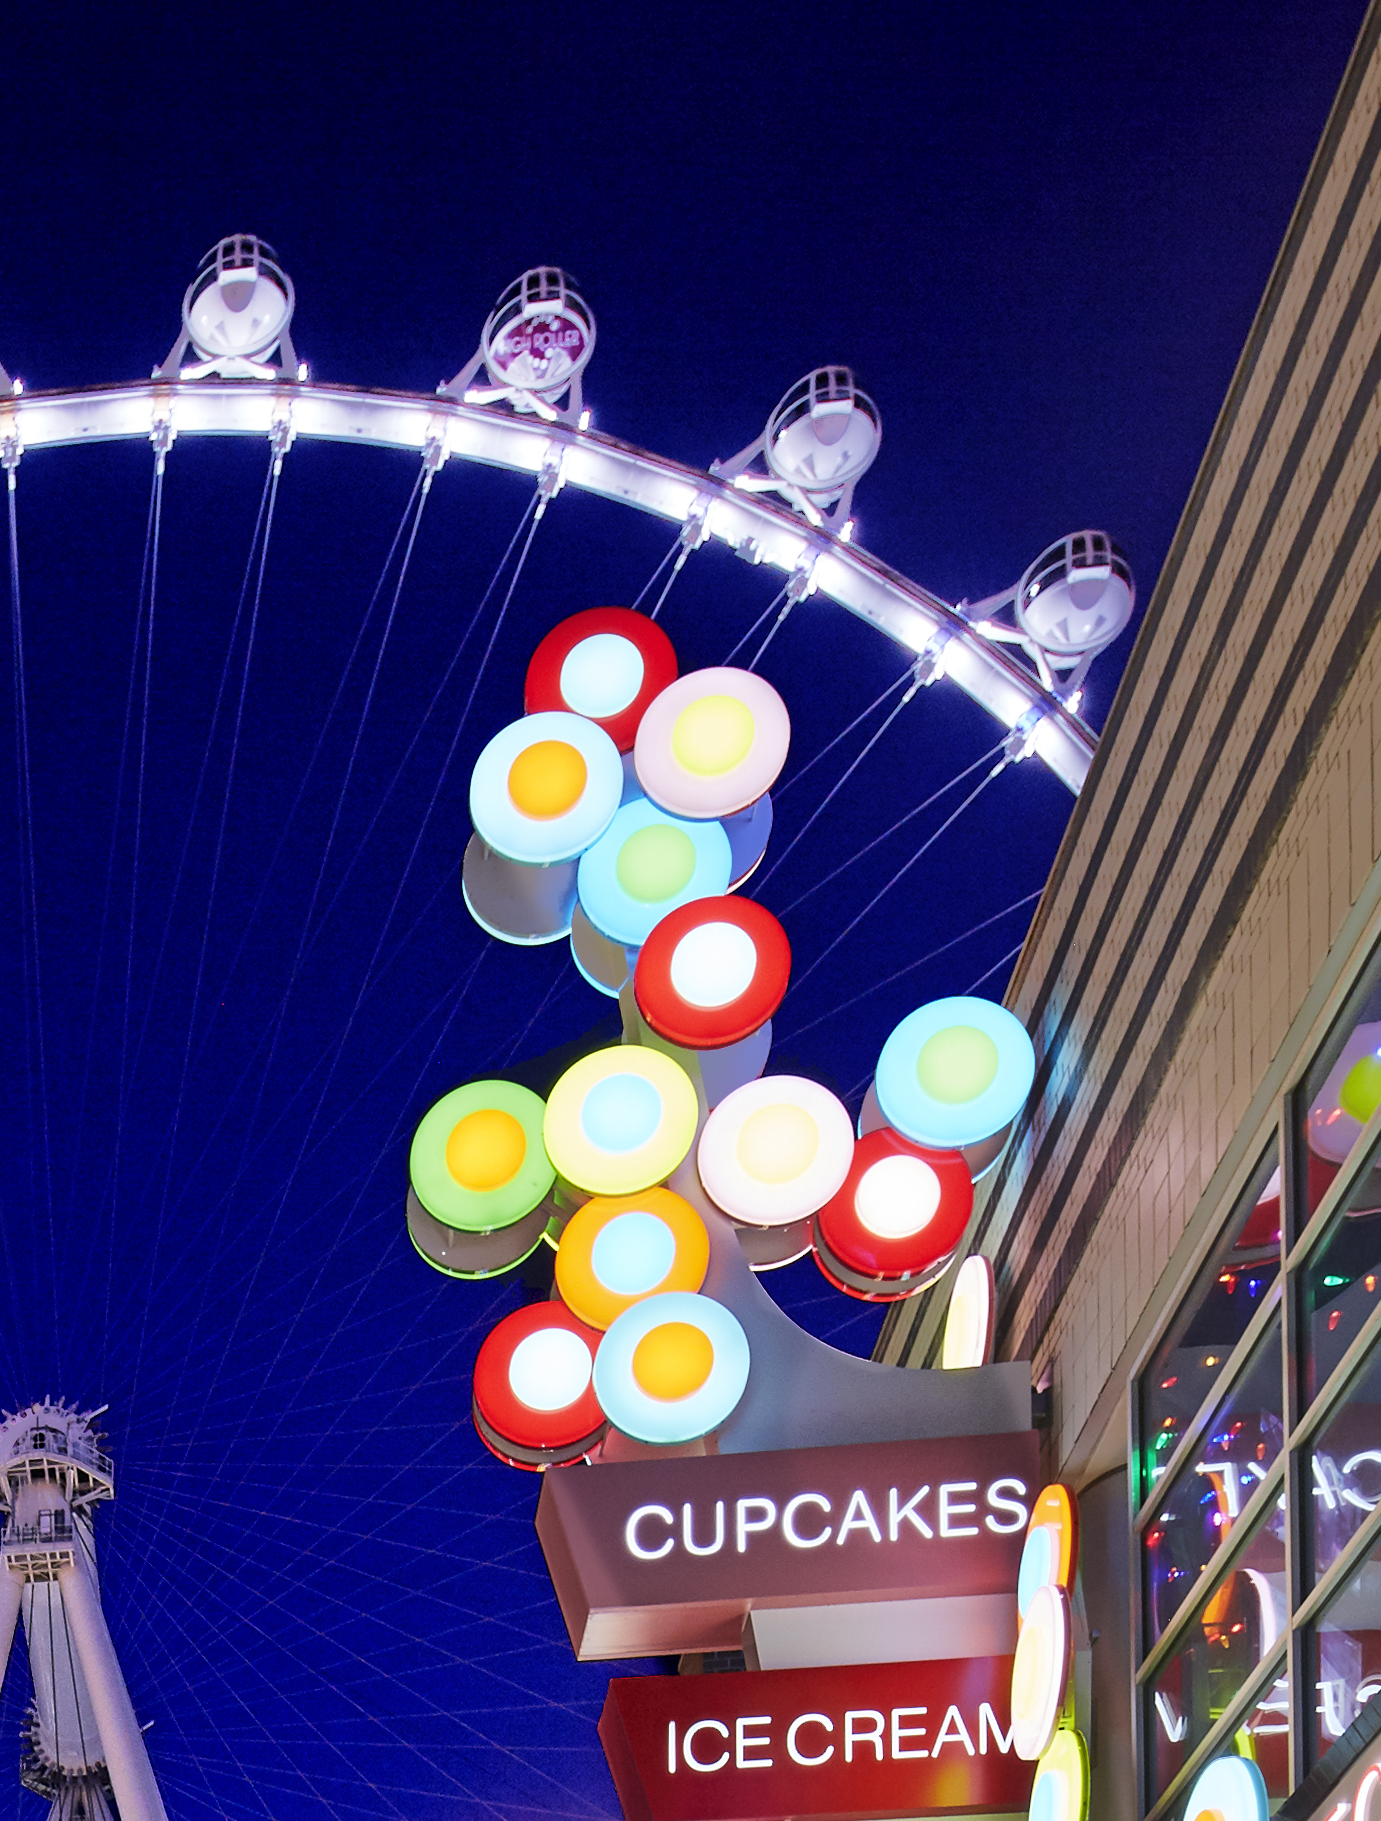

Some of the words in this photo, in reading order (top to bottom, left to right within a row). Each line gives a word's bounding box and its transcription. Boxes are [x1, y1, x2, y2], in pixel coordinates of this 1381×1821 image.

[623, 1477, 1029, 1562] CUPCAKES
[666, 1713, 774, 1774] ICE
[786, 1702, 1014, 1767] CREAM
